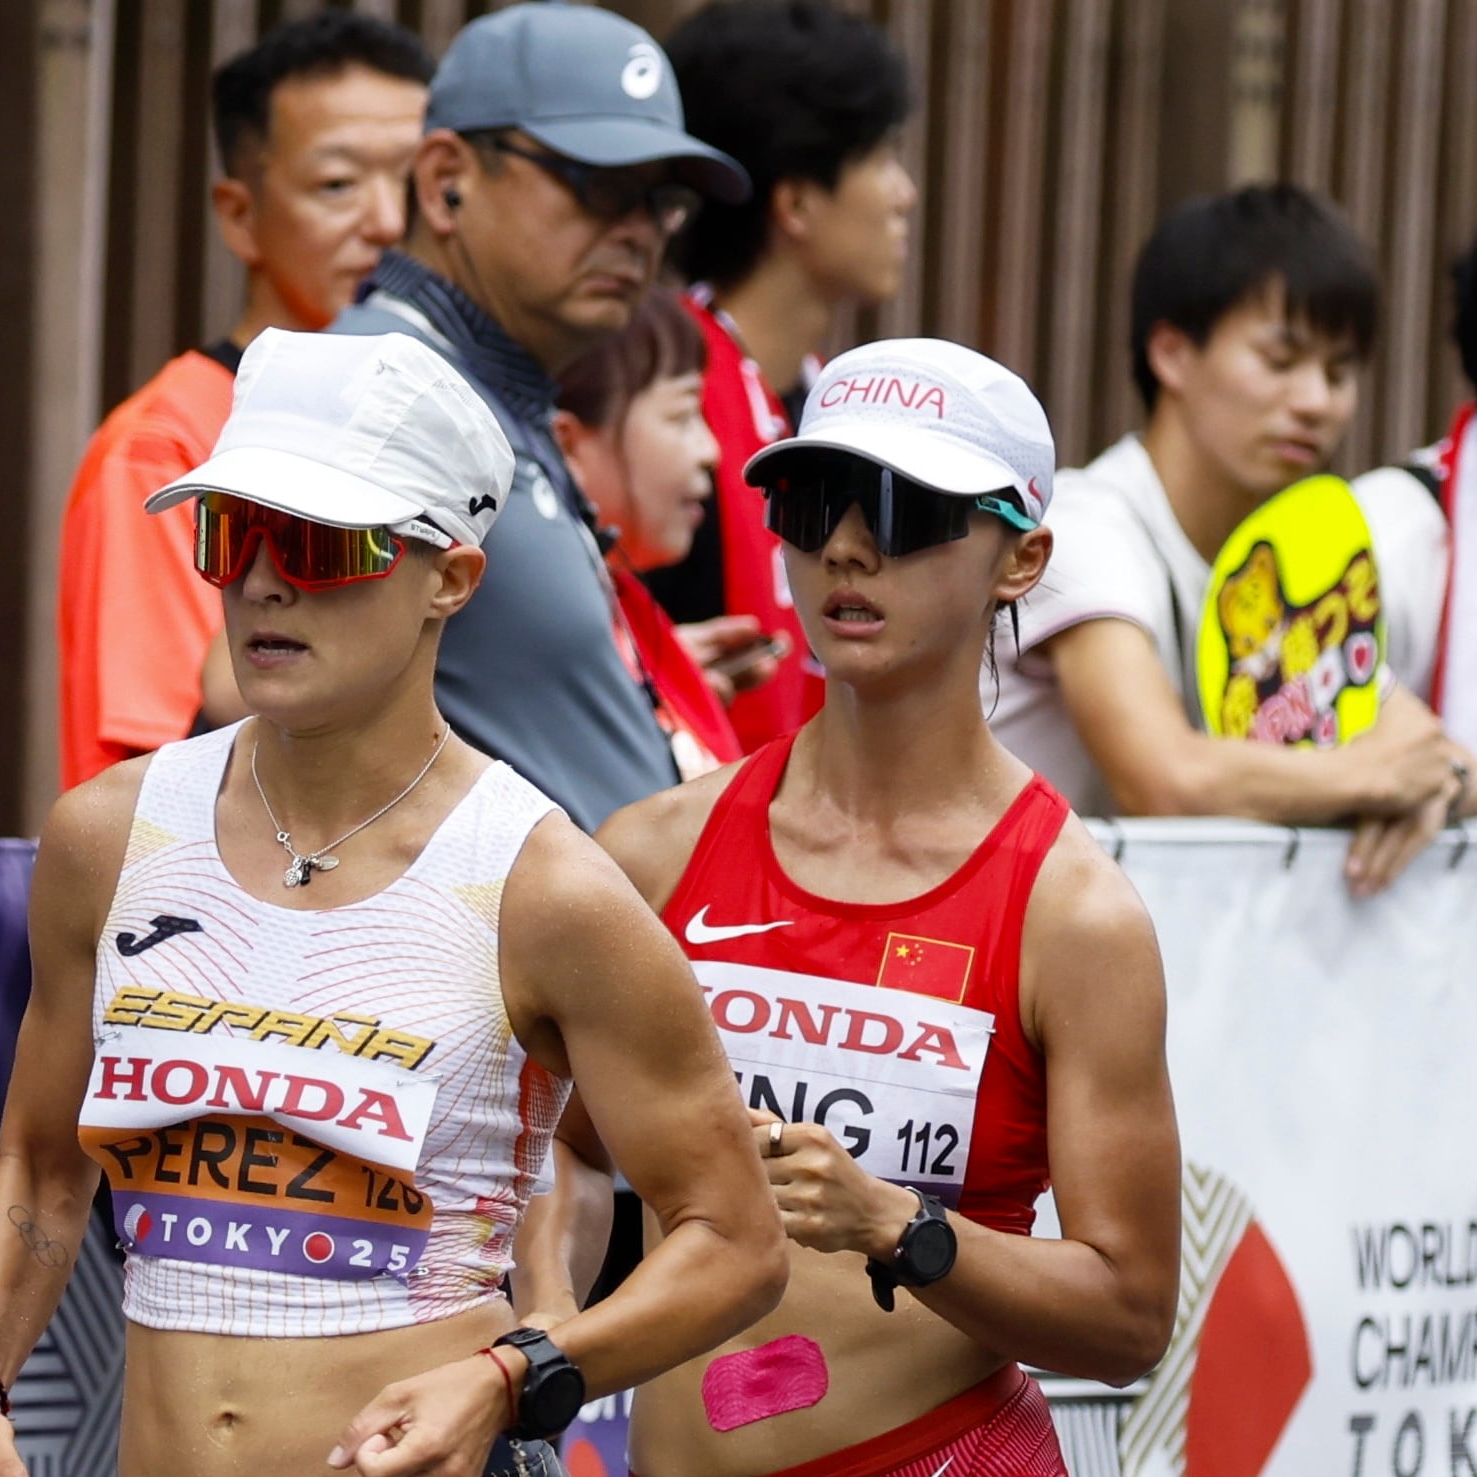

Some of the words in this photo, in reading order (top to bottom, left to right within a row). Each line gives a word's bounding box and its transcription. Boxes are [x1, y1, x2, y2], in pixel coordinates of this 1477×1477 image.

[820, 377, 944, 419] CHINA
[103, 986, 436, 1071] ESPAÑA
[701, 986, 972, 1072] ONDA
[93, 1056, 414, 1143] HONDA
[100, 1120, 337, 1204] PEREZ
[897, 1119, 959, 1176] 112
[349, 1239, 411, 1272] 25
